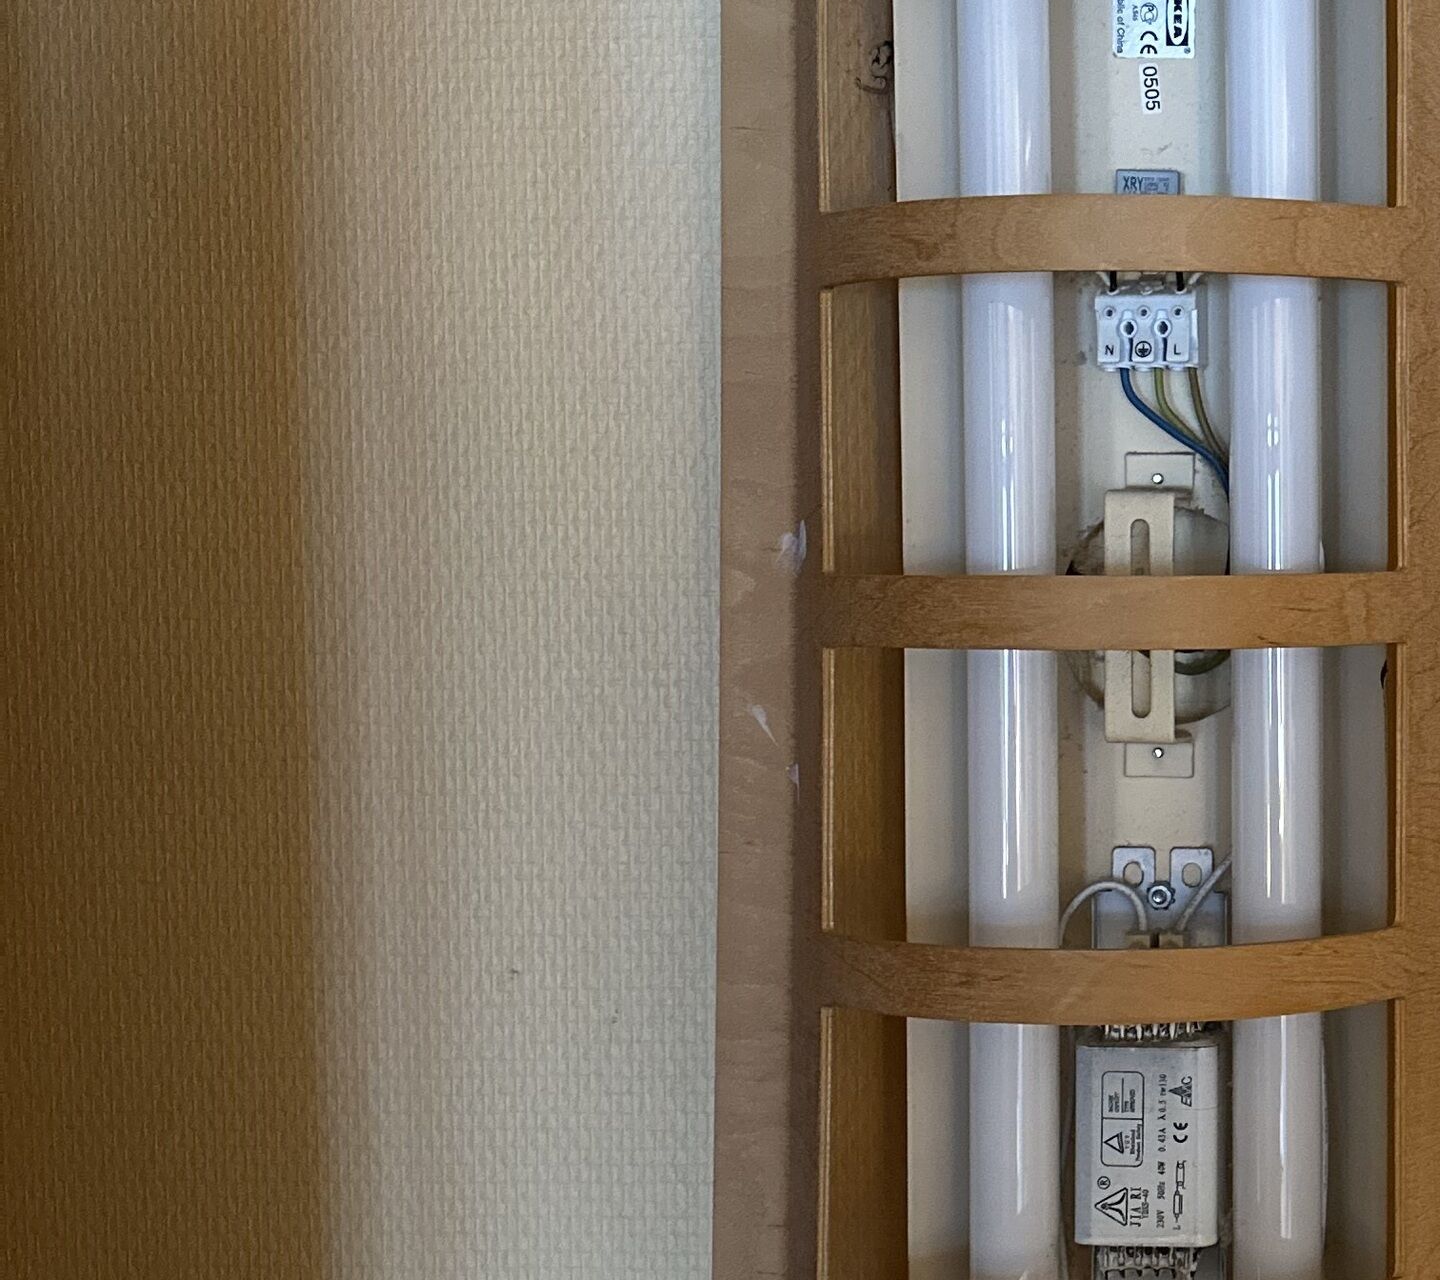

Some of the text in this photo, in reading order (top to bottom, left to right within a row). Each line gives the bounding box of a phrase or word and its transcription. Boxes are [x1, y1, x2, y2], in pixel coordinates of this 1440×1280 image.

[1117, 17, 1125, 25] of
[1117, 28, 1125, 53] China
[1143, 66, 1160, 111] 0505
[1105, 344, 1181, 355] N L
[1130, 1187, 1141, 1227] JIA RI
